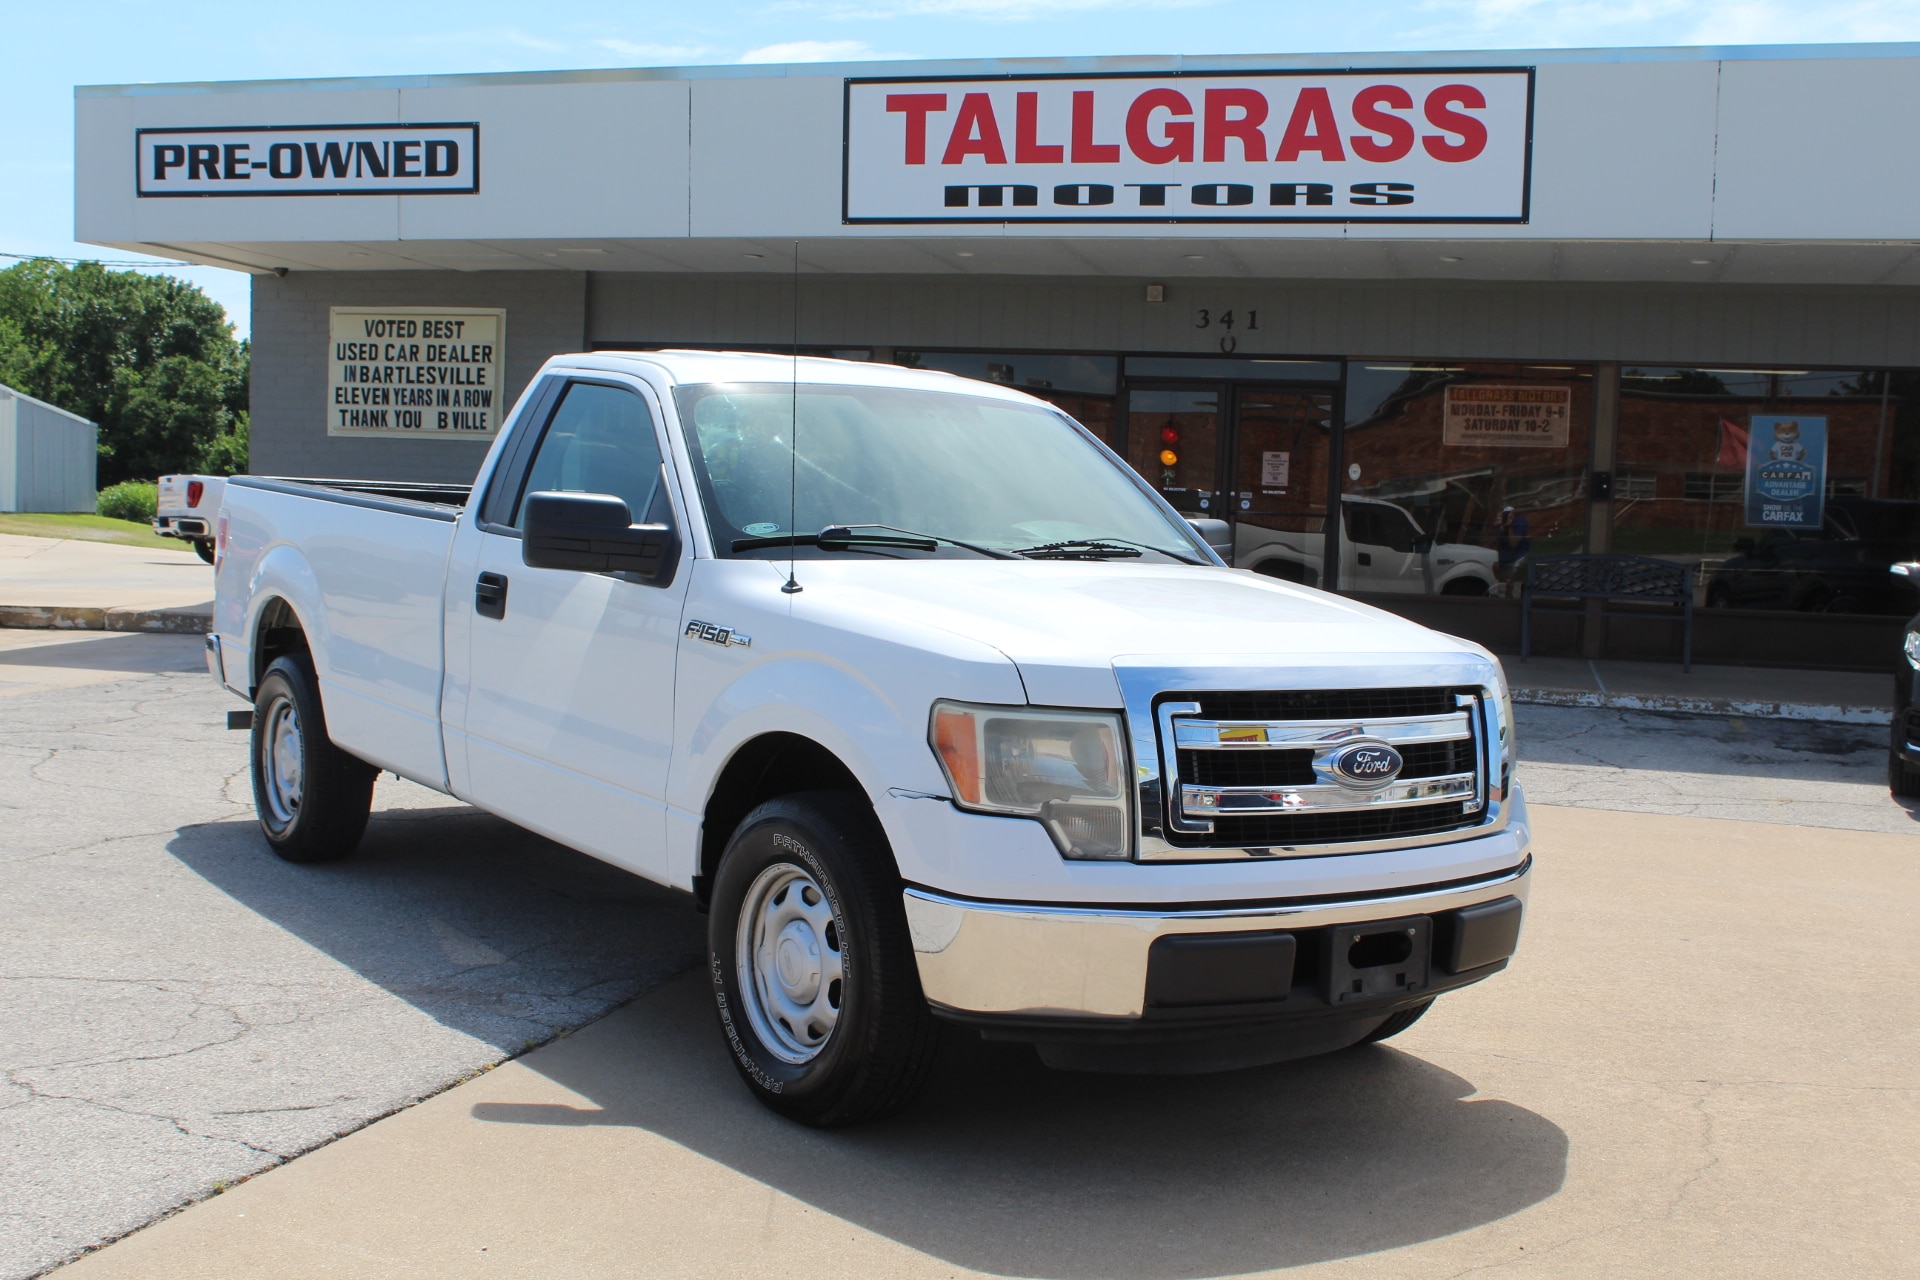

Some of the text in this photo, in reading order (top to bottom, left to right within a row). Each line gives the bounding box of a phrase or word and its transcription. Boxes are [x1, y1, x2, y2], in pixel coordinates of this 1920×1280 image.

[886, 84, 1488, 165] TALLGRASS
[153, 140, 459, 181] PRE-OWNED
[944, 183, 1415, 207] MOTORS
[364, 319, 465, 339] VOTED BEST
[336, 343, 493, 363] USED CAR DEALER
[335, 387, 493, 408] ELEVEN YEARS IN A ROW
[1452, 388, 1565, 403] TALLGRASS MOTORS
[339, 409, 487, 430] THANK YOU B VILLE
[1450, 403, 1565, 419] MONDAY-FRIDAY 9-6
[1464, 418, 1550, 433] SATURDAY 10-2
[1764, 481, 1807, 489] ADVANTAGE
[1762, 510, 1804, 522] CARFAX
[1353, 751, 1391, 774] Ford
[773, 833, 846, 933] PATHFINDER
[717, 992, 784, 1094] PATHFINDER
